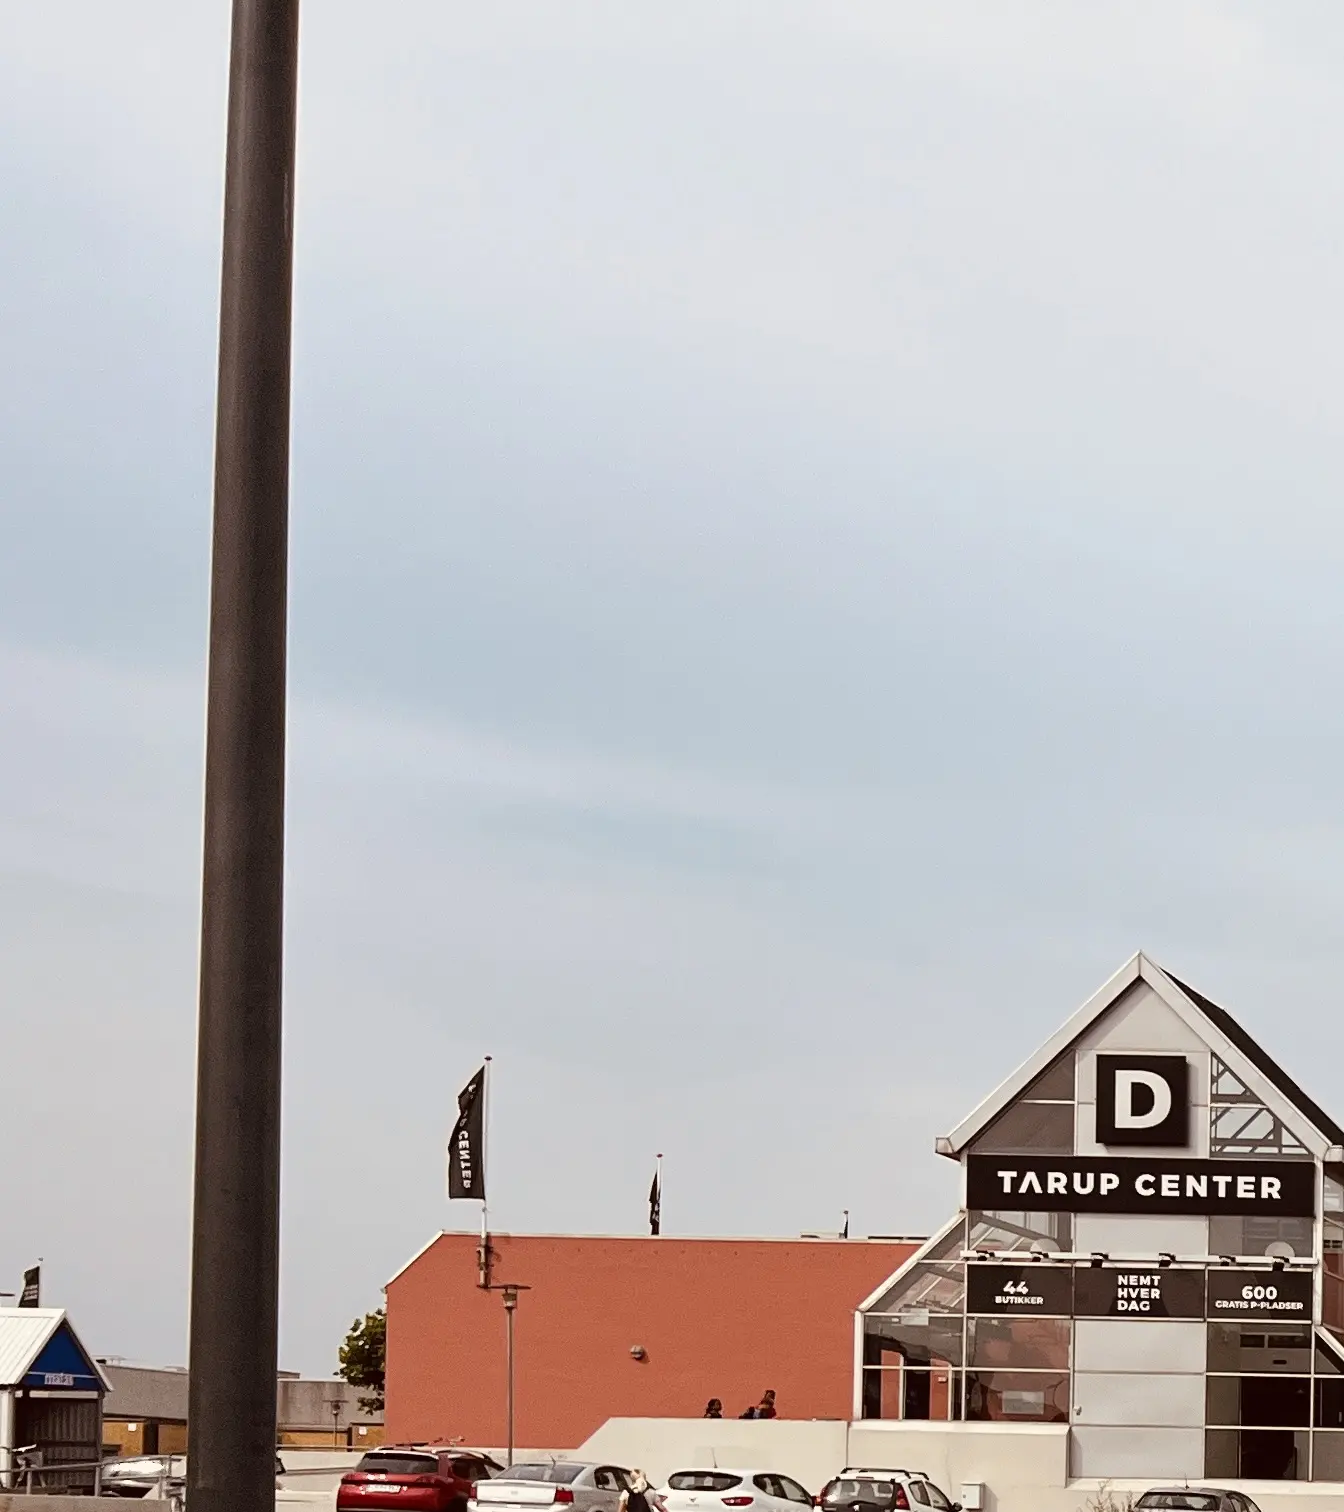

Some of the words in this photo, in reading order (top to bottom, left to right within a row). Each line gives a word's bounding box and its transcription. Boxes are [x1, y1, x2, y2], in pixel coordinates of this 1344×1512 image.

[1115, 1070, 1171, 1128] D
[997, 1170, 1120, 1196] TARUP
[1135, 1174, 1281, 1199] CENTER
[1117, 1274, 1161, 1286] NEMT
[1003, 1280, 1029, 1295] 44
[1117, 1287, 1161, 1299] HVER
[1241, 1285, 1278, 1300] 600
[994, 1295, 1044, 1305] BUTIKKER
[1117, 1300, 1150, 1312] DAG
[1215, 1299, 1249, 1310] GRATIS
[1250, 1300, 1304, 1311] P-PLADSER
